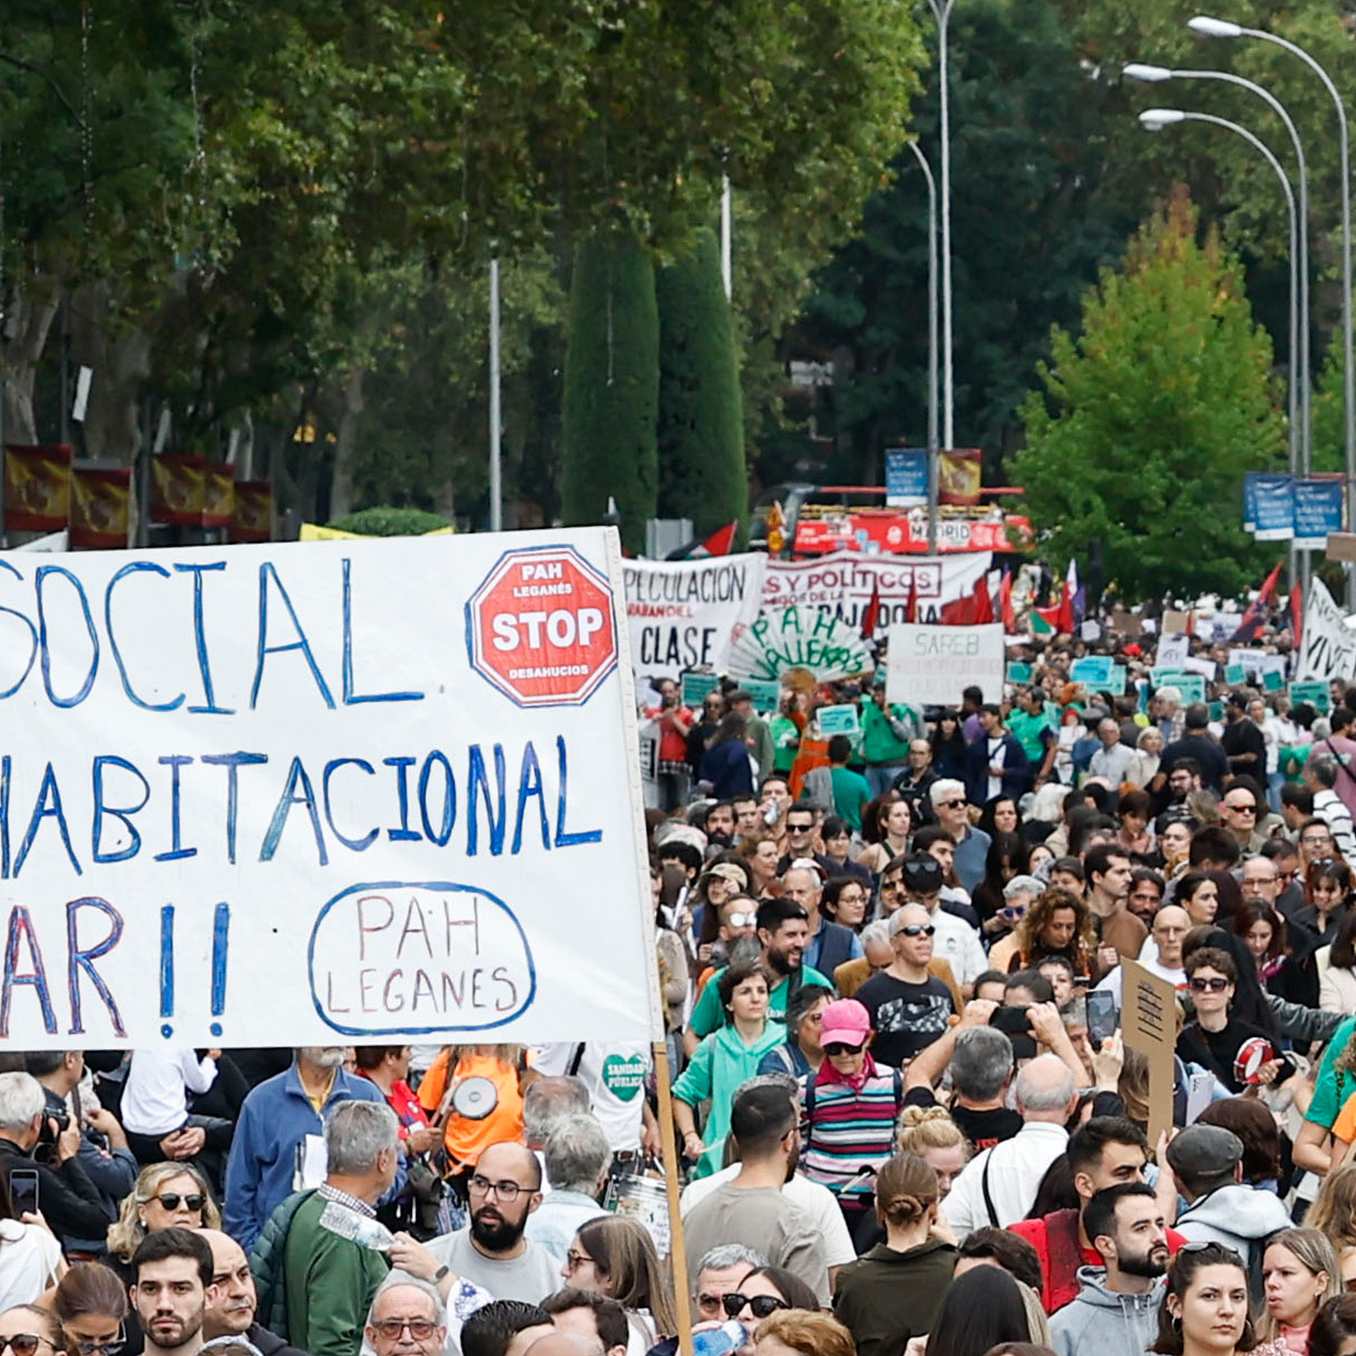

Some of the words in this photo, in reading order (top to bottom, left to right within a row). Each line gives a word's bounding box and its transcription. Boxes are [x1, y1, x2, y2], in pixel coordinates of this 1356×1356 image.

[911, 524, 970, 539] MRID
[521, 563, 564, 581] PAH
[513, 583, 573, 598] LEGANÉS
[785, 574, 802, 592] Y
[492, 608, 604, 652] STOP
[641, 625, 717, 668] CLASE
[914, 633, 981, 656] SAREB
[509, 664, 590, 680] DESAHUCIOS
[357, 894, 481, 963] PAH
[325, 966, 519, 1014] LEGANES
